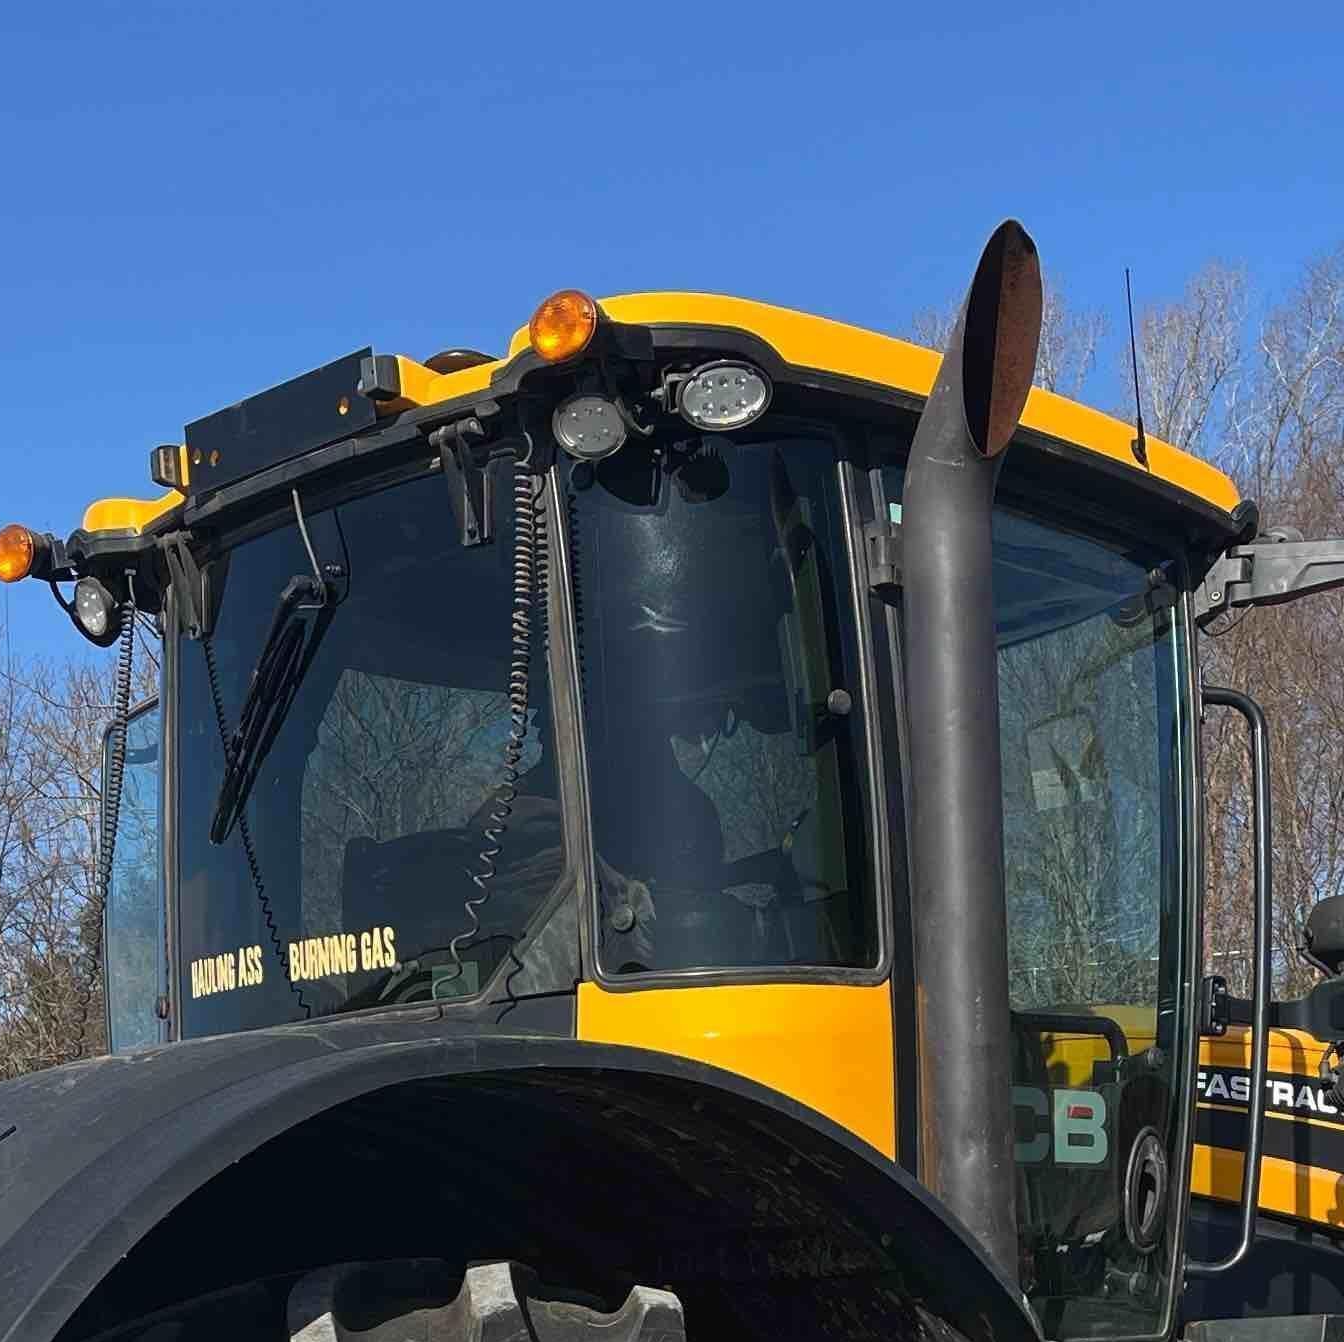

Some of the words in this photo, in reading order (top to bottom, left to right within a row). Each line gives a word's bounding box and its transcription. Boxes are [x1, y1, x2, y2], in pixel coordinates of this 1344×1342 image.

[191, 952, 236, 999] HAULING
[238, 944, 263, 987] ASS
[288, 931, 357, 982] BURNING
[360, 926, 395, 970] GAS
[1197, 1072, 1338, 1114] ASRAC
[1010, 1086, 1107, 1164] CB
